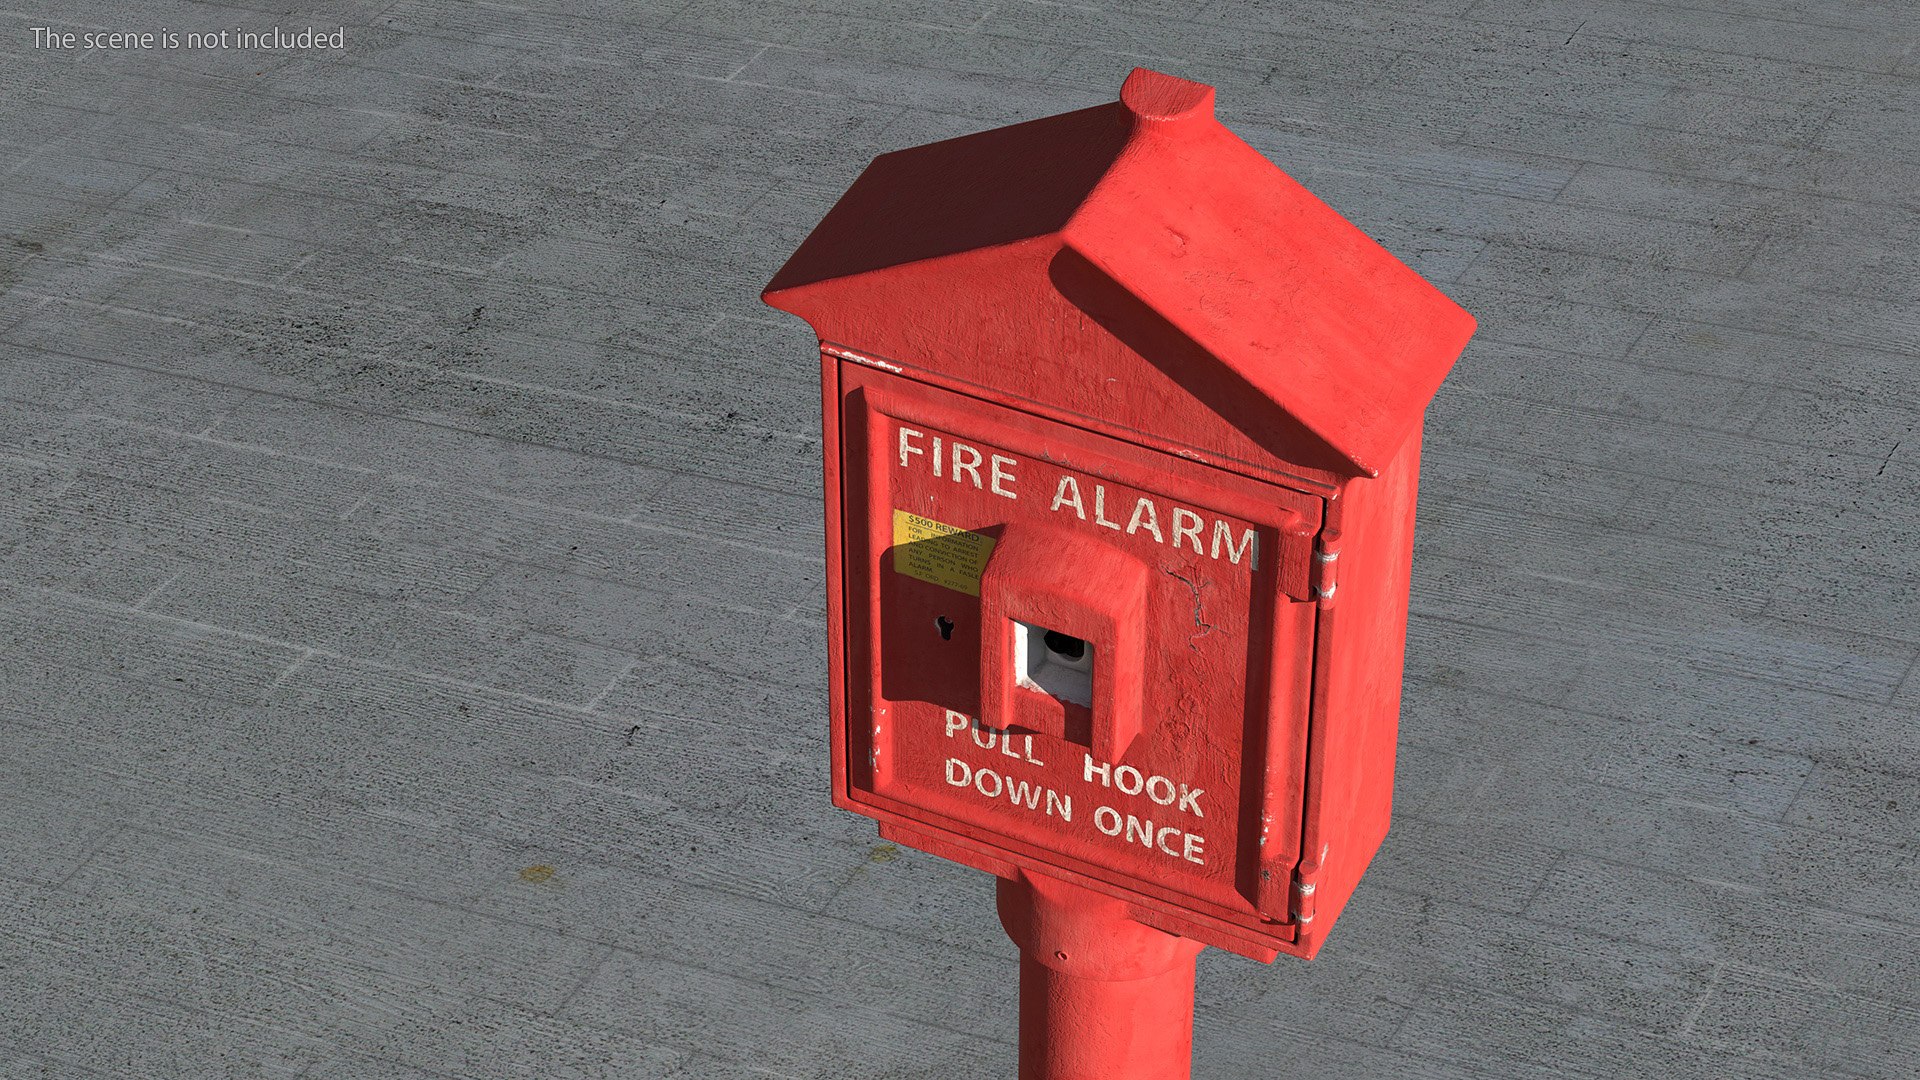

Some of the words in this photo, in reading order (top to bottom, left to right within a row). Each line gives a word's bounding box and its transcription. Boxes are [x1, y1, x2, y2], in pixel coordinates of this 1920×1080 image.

[899, 427, 1017, 500] FIRE
[1050, 475, 1259, 571] ALARM
[908, 514, 933, 528] $500
[935, 522, 980, 541] REWARD
[908, 526, 922, 535] FOR
[930, 533, 979, 552] INFORMATION
[908, 533, 938, 546] LEADING
[953, 545, 978, 559] ARREST
[908, 541, 923, 549] AND
[925, 545, 968, 562] CONVICTION
[908, 548, 923, 556] ANY
[928, 553, 956, 566] PERSON
[960, 563, 979, 572] WHO
[908, 561, 933, 572] ALARM
[909, 554, 931, 566] TURNS
[936, 561, 944, 569] IN
[945, 709, 1044, 766] PULL
[1083, 753, 1205, 818] HOOK
[945, 757, 1072, 822] DOWN
[1094, 805, 1205, 865] ONCE
